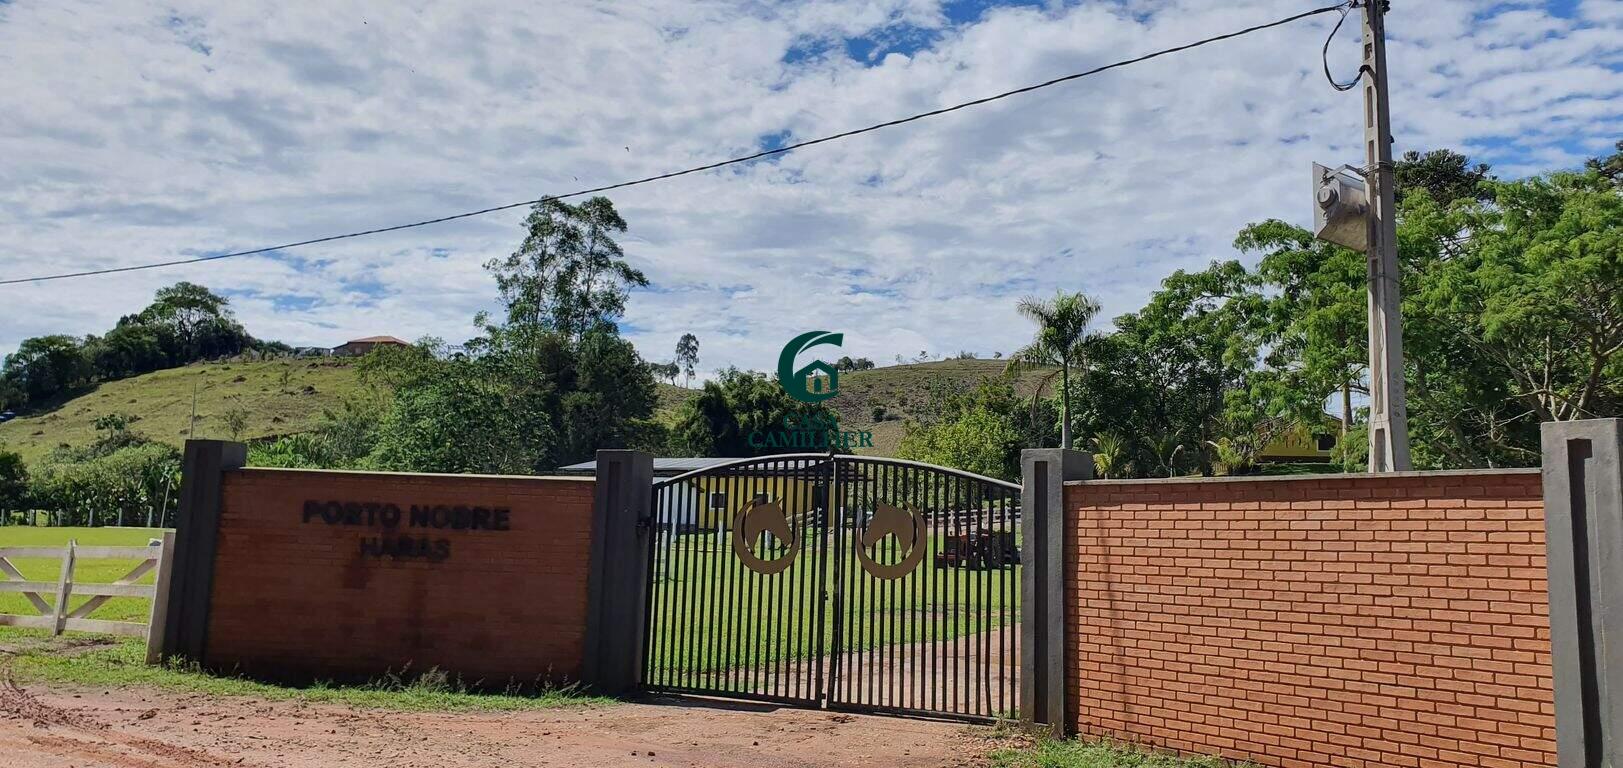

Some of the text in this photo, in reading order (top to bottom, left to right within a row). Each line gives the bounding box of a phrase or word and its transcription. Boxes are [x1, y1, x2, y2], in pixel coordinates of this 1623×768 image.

[303, 500, 511, 531] PORTO NOBRE
[359, 535, 451, 561] HARAS
